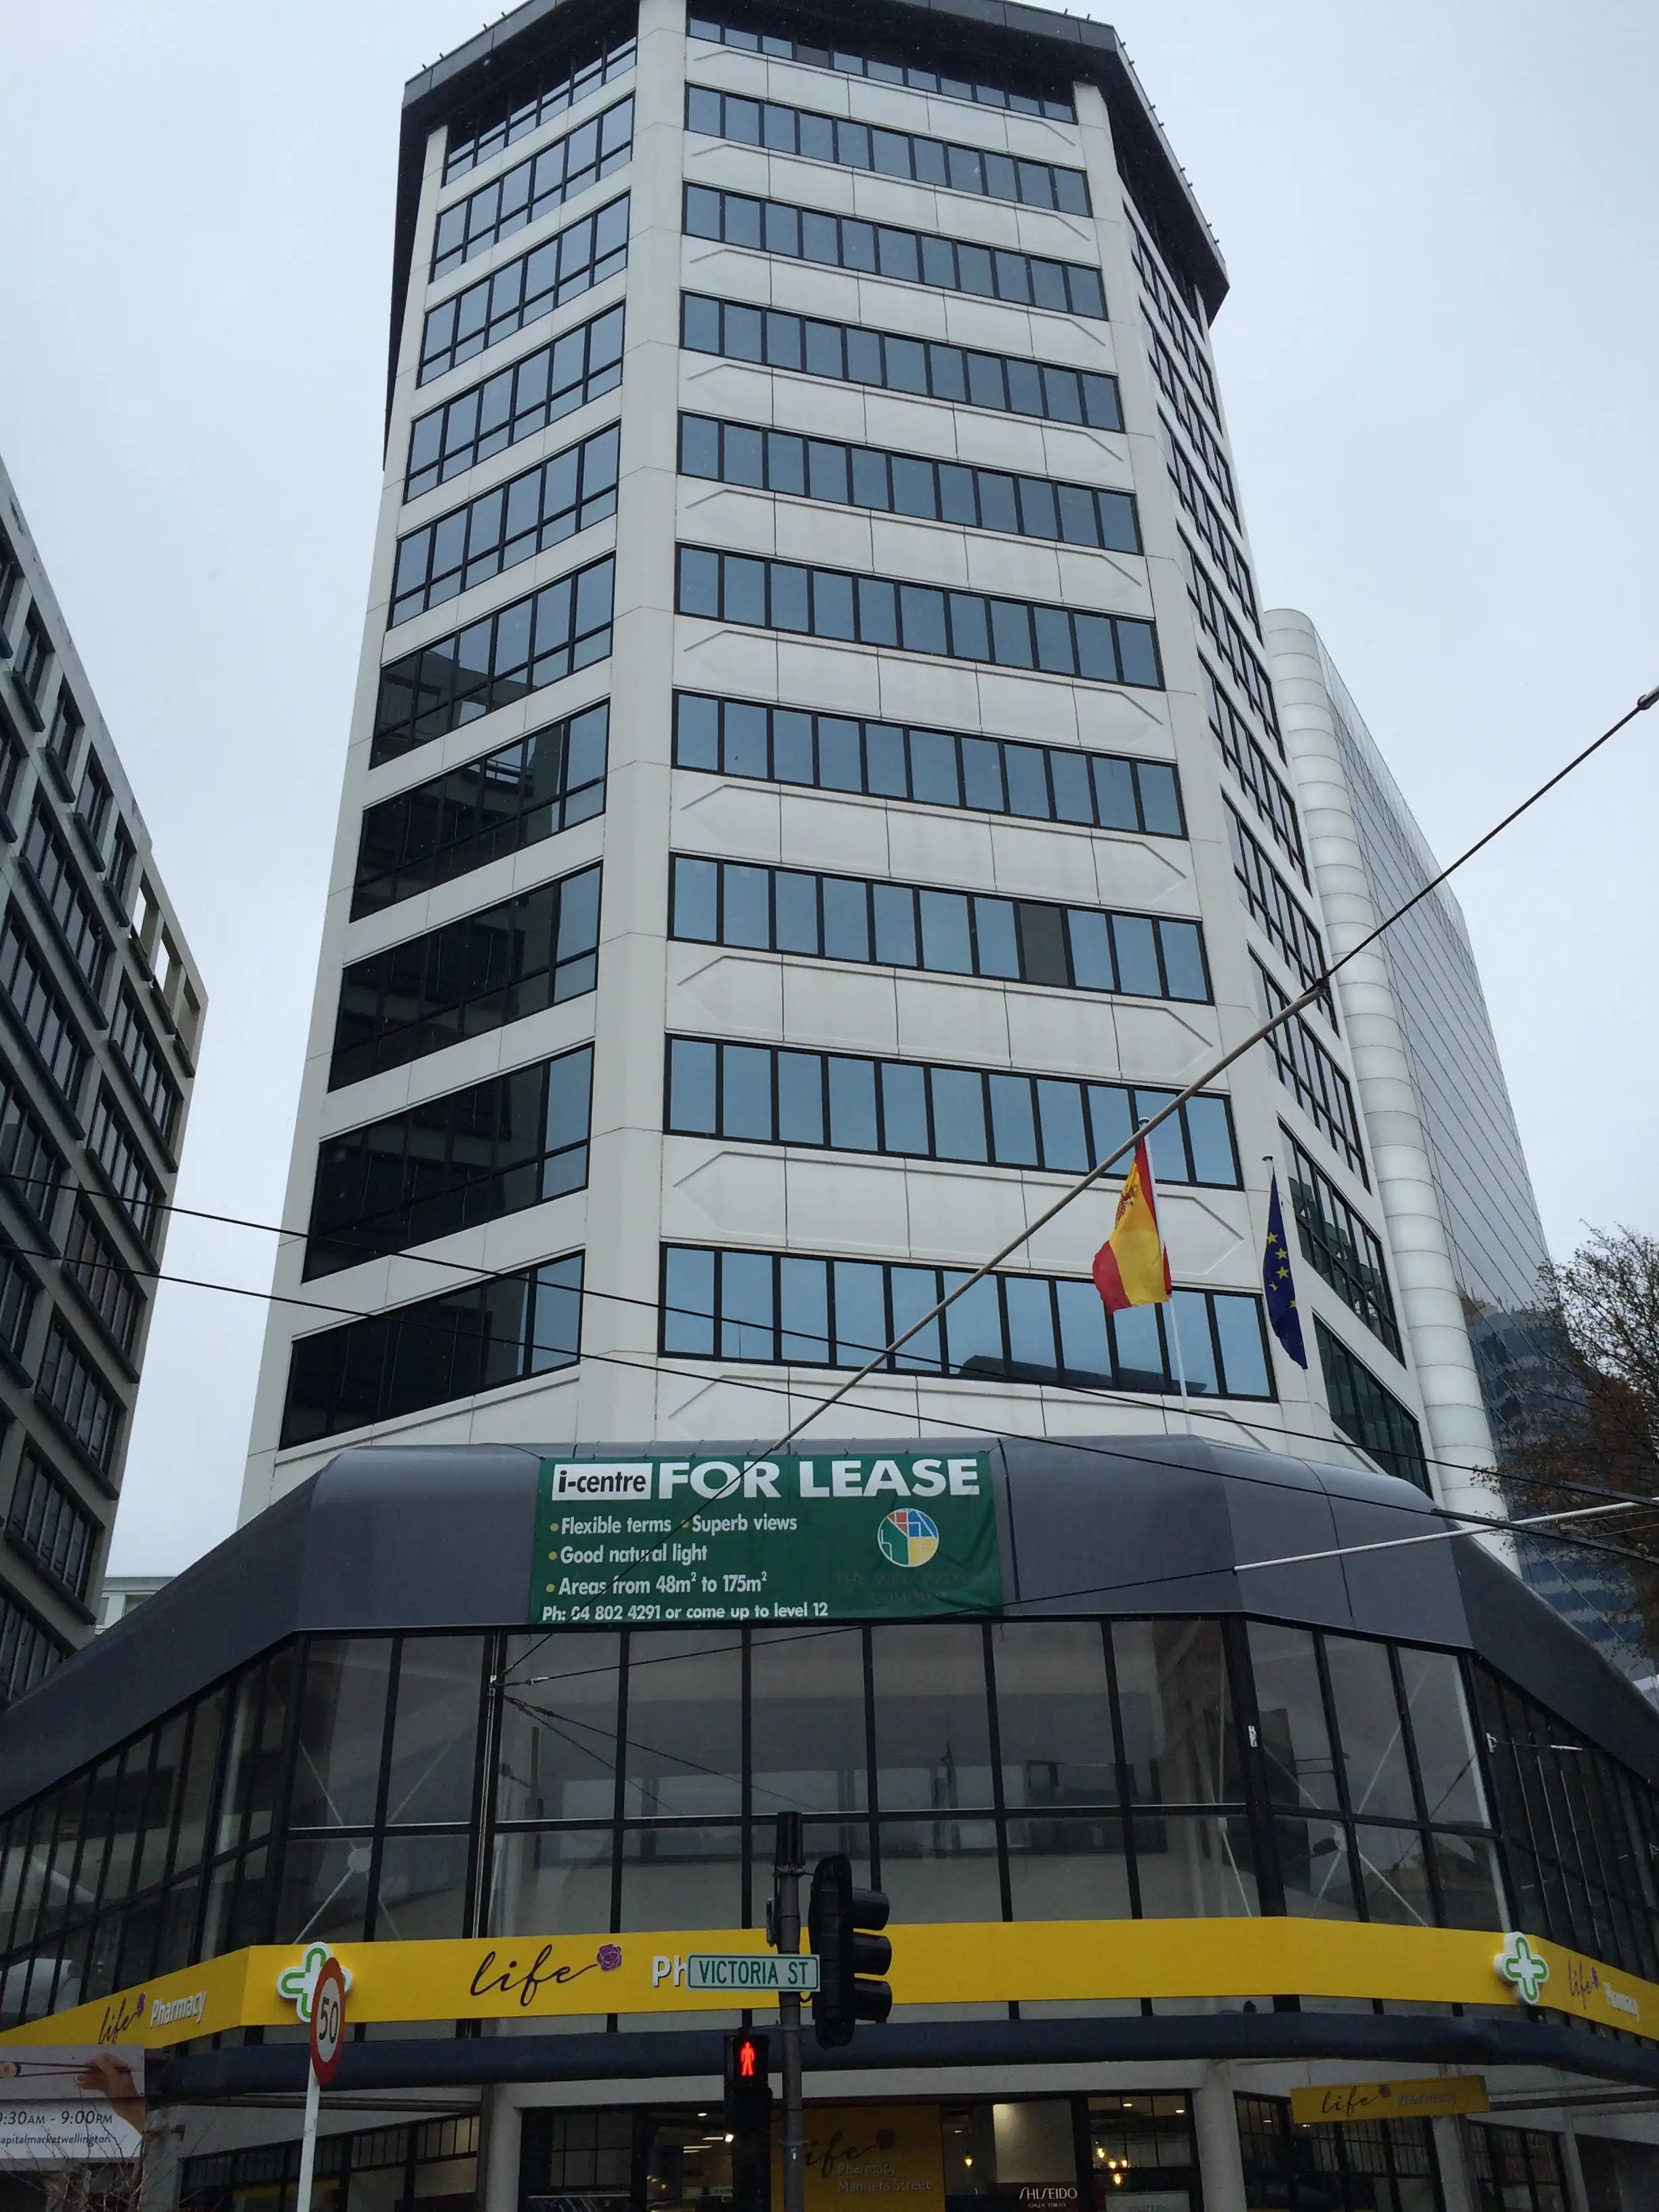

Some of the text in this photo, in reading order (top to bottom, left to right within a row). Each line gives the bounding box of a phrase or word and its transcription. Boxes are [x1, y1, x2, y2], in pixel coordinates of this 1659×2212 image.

[558, 1458, 980, 1500] i-centre FOR LEASE
[561, 1513, 798, 1536] Flexible terms Superb views
[560, 1542, 708, 1565] Good natural light
[558, 1578, 607, 1595] Areas
[613, 1575, 651, 1594] from
[701, 1576, 717, 1592] to
[542, 1601, 828, 1621] Ph: 04 802 4291 or come up to level 12
[470, 1944, 598, 2006] life
[699, 1960, 779, 1985] VICTORIA
[787, 1961, 808, 1985] ST
[98, 1991, 207, 2045] life Pharmacy
[319, 1996, 338, 2044] 50
[1322, 2085, 1380, 2118] life
[61, 2110, 112, 2125] 9:00PM
[0, 2133, 110, 2147] apitalmarketwellington
[803, 2129, 878, 2177] ife
[838, 2163, 897, 2176] Pharmacy
[839, 2178, 932, 2192] Manners Street
[1019, 2187, 1078, 2200] SHISEIDO
